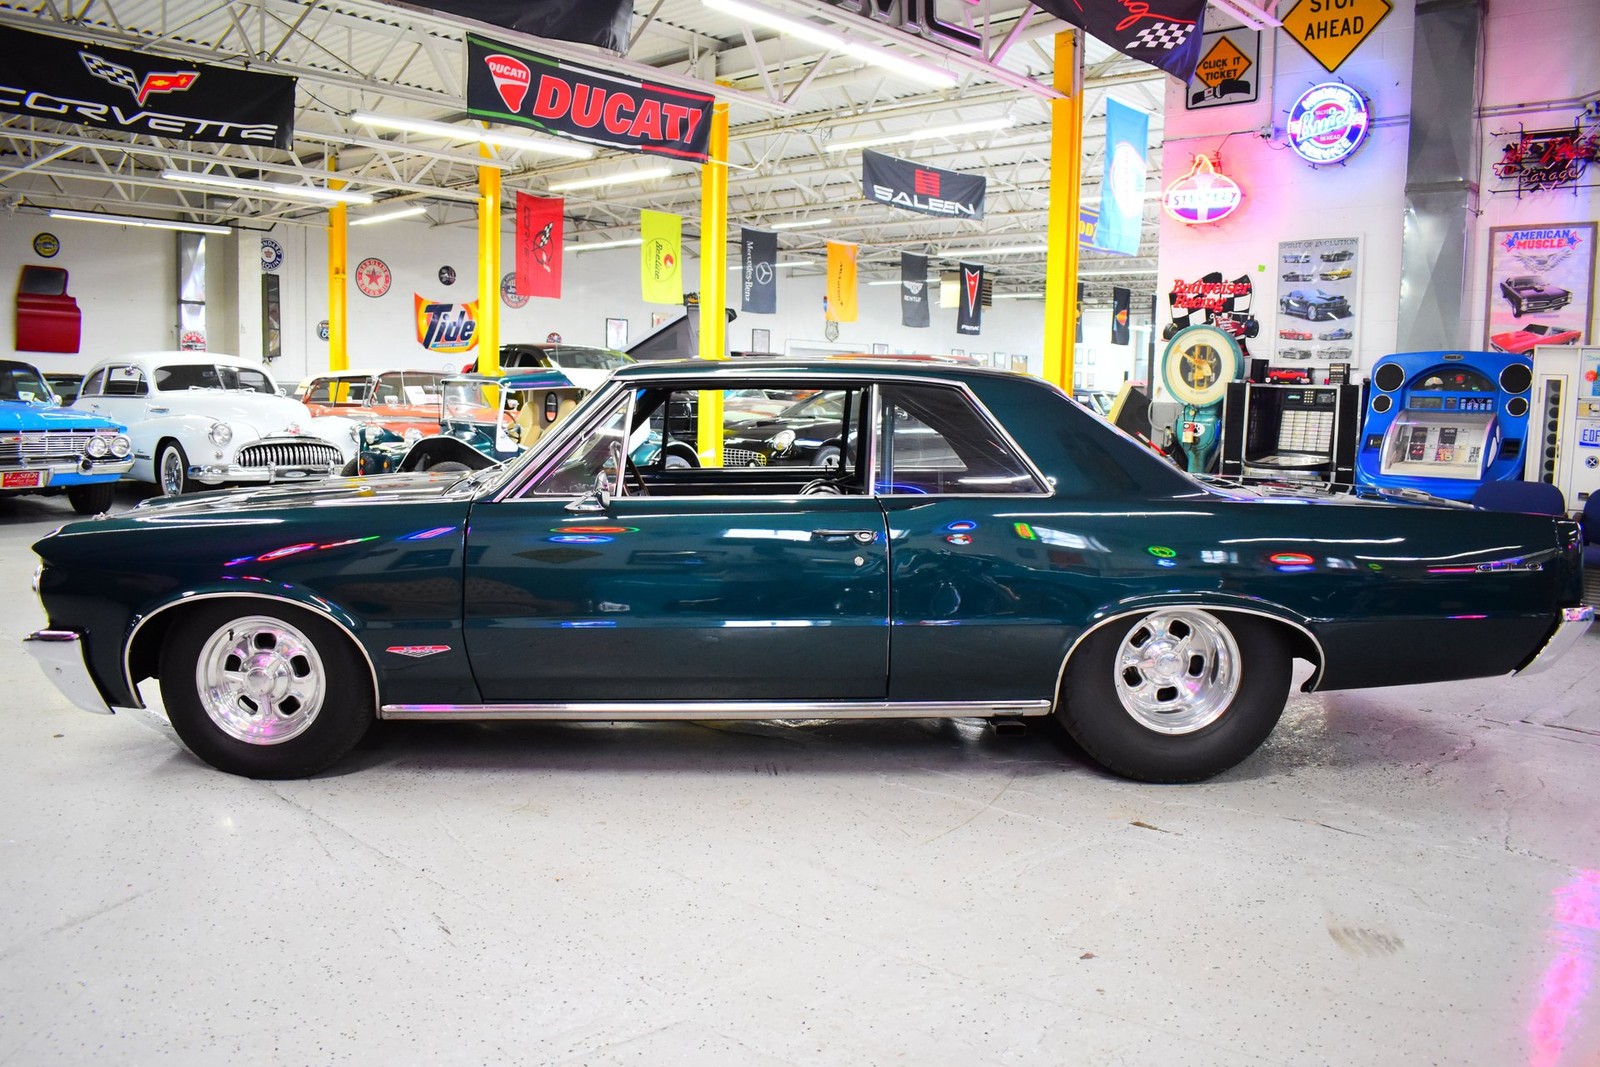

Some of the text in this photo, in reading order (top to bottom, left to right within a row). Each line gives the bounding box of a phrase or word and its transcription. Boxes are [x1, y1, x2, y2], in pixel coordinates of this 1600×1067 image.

[1304, 16, 1364, 41] AHEAD
[488, 62, 527, 80] DUCATI
[1203, 56, 1242, 71] CLICK IT
[1205, 69, 1238, 81] TICKET
[532, 74, 703, 143] DUCATI
[873, 184, 975, 215] SALEEN
[1512, 229, 1571, 240] AMERICAN
[1517, 239, 1564, 249] MUSCLE
[744, 240, 754, 302] Mercedes-Benz
[1170, 279, 1252, 294] Budweiser
[1173, 293, 1227, 313] Racing
[423, 303, 476, 350] Tide
